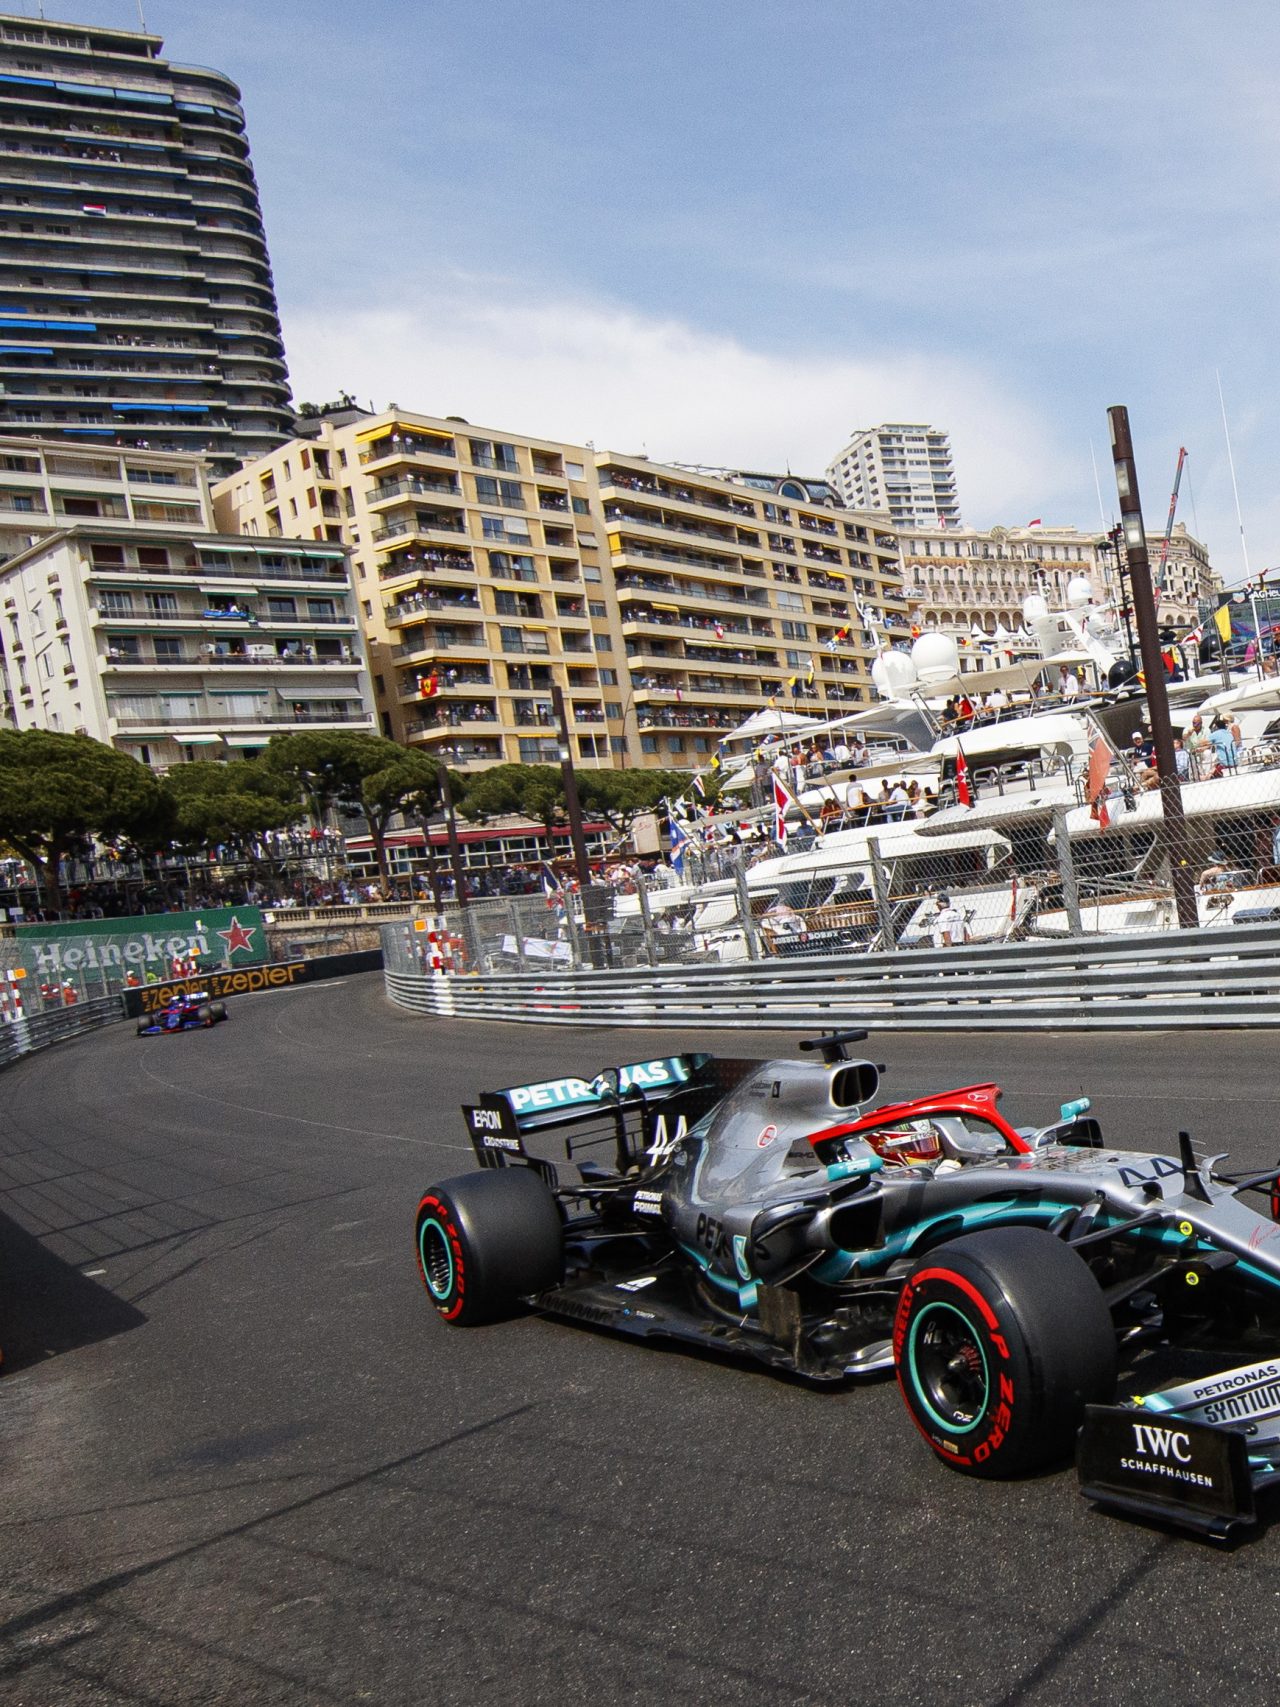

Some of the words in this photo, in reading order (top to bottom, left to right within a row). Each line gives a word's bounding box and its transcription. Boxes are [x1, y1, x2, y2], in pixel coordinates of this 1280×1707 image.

[32, 930, 210, 974] Heineken
[220, 963, 305, 994] zepter
[989, 1331, 1011, 1360] P
[1194, 1365, 1278, 1399] PETRONAS
[973, 1372, 1015, 1464] ZERO
[1132, 1424, 1192, 1462] IWC
[1120, 1457, 1213, 1487] SCHAFFHAUSEN
